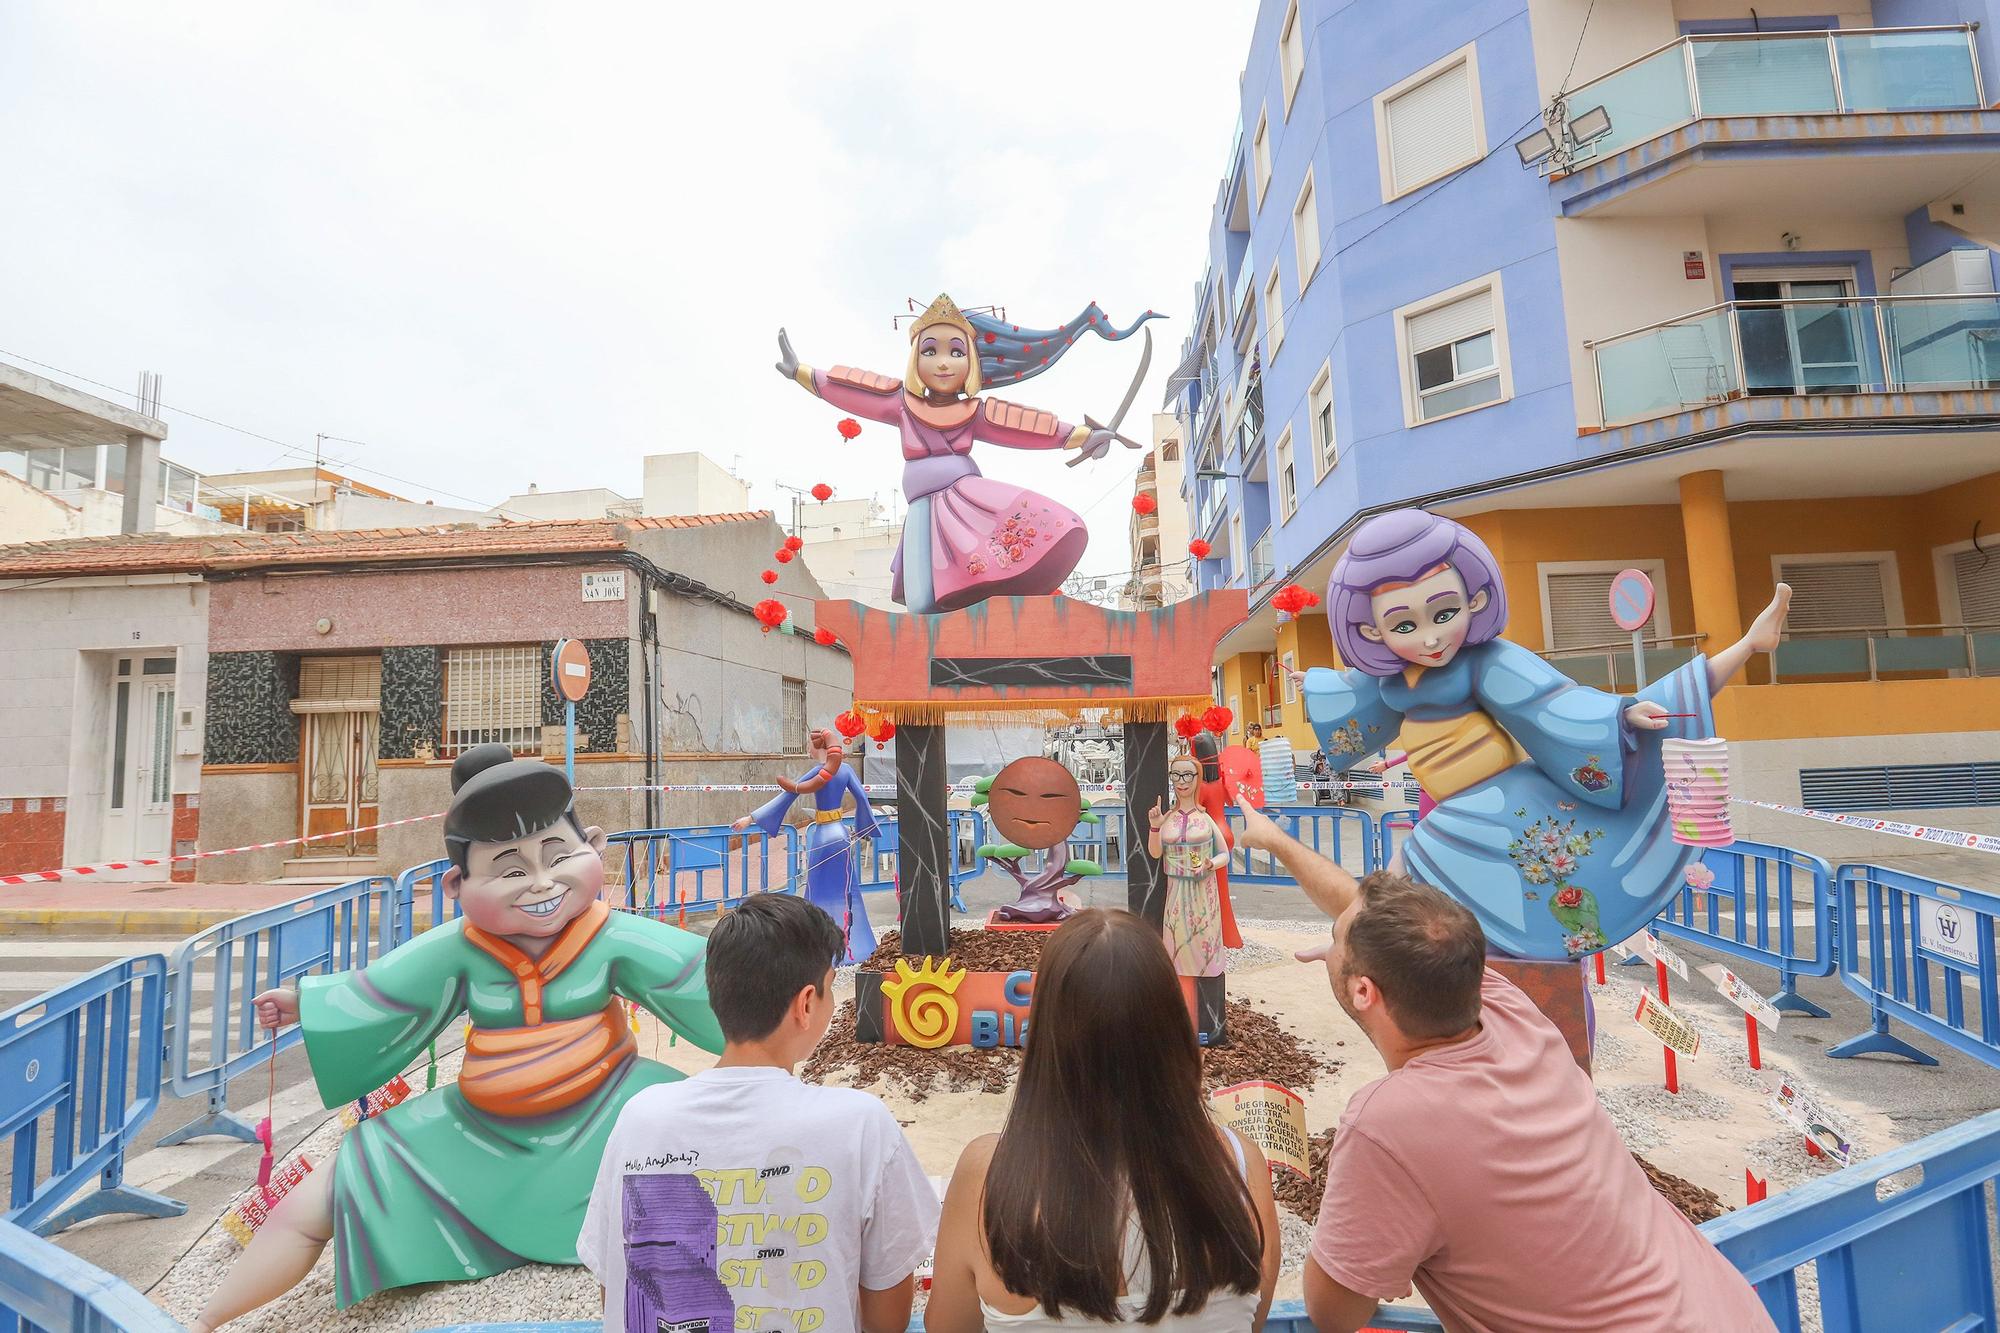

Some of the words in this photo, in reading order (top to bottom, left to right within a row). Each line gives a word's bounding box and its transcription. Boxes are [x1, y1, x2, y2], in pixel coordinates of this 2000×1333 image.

[585, 588, 599, 598] SAN
[132, 632, 140, 640] 15
[1922, 828, 1944, 842] LOCAL
[1942, 830, 1968, 846] POLICIA
[1937, 940, 1968, 959] Ingenieros,
[1668, 1021, 1678, 1037] GATO
[1670, 1026, 1684, 1049] HOGUER
[1235, 1101, 1250, 1111] QUE
[1252, 1100, 1291, 1115] GRASIOSA
[1245, 1108, 1282, 1120] NUESTRA
[1228, 1116, 1273, 1128] CONSEJALA
[1275, 1119, 1290, 1130] QUE
[1290, 1125, 1298, 1135] EN
[1258, 1125, 1294, 1140] HOGUERA
[1248, 1132, 1277, 1142] ALTAR,
[1279, 1136, 1290, 1146] NO
[1262, 1141, 1284, 1152] OTRA
[1285, 1146, 1302, 1161] IGUAL
[760, 1166, 791, 1178] STWD
[757, 1248, 785, 1259] STWD
